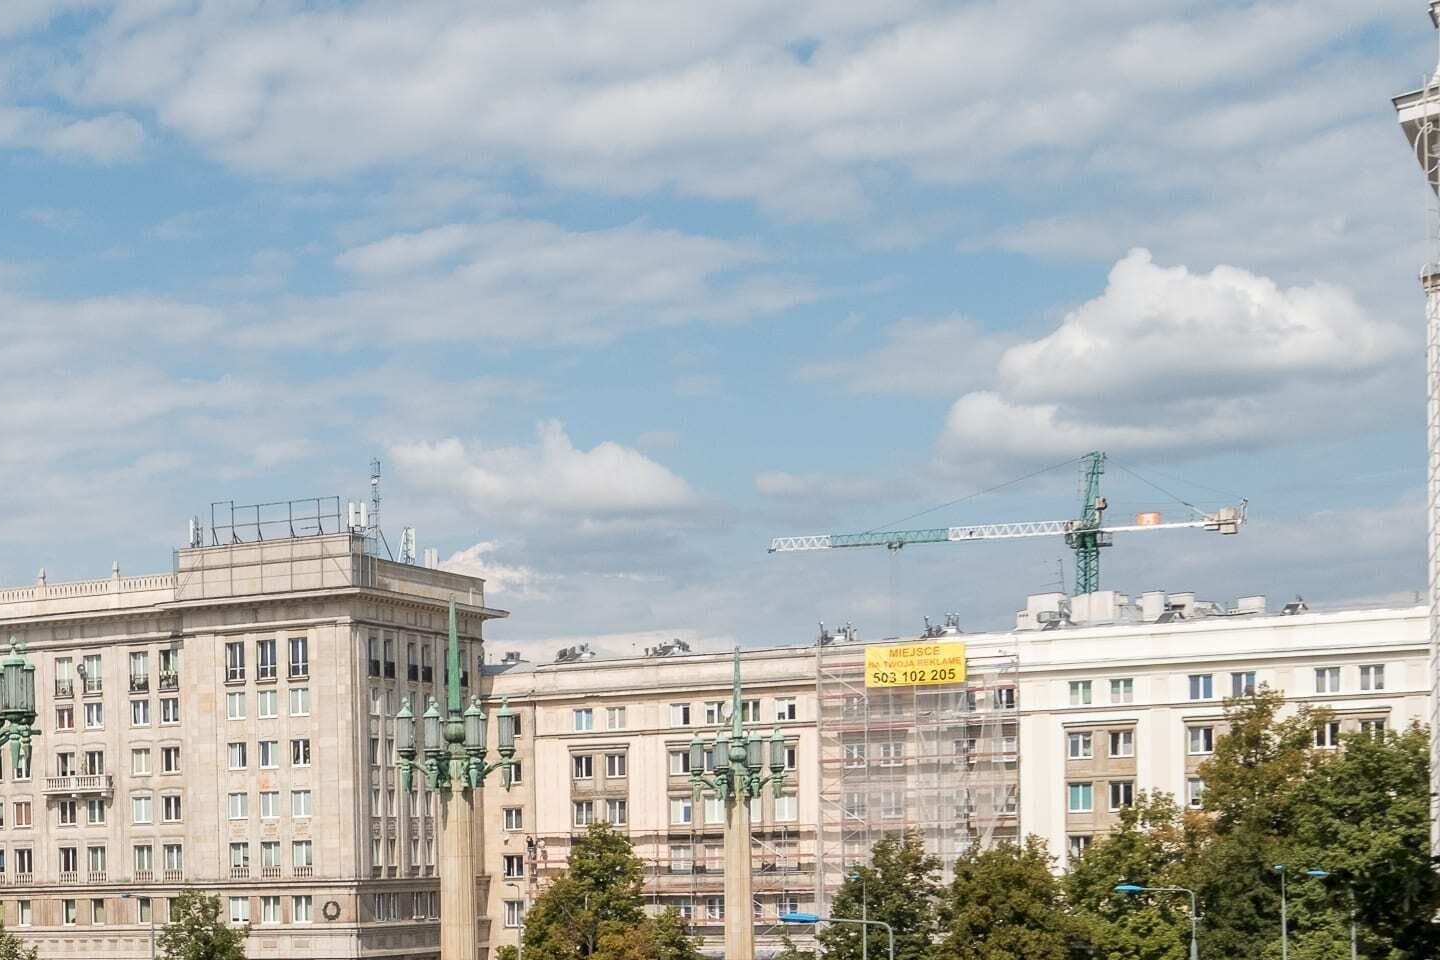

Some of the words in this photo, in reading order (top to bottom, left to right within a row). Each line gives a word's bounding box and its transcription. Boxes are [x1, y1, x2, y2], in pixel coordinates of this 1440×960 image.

[889, 646, 940, 657] MIEJSCE
[873, 671, 896, 684] 503
[902, 670, 926, 682] 102
[931, 668, 956, 681] 205
